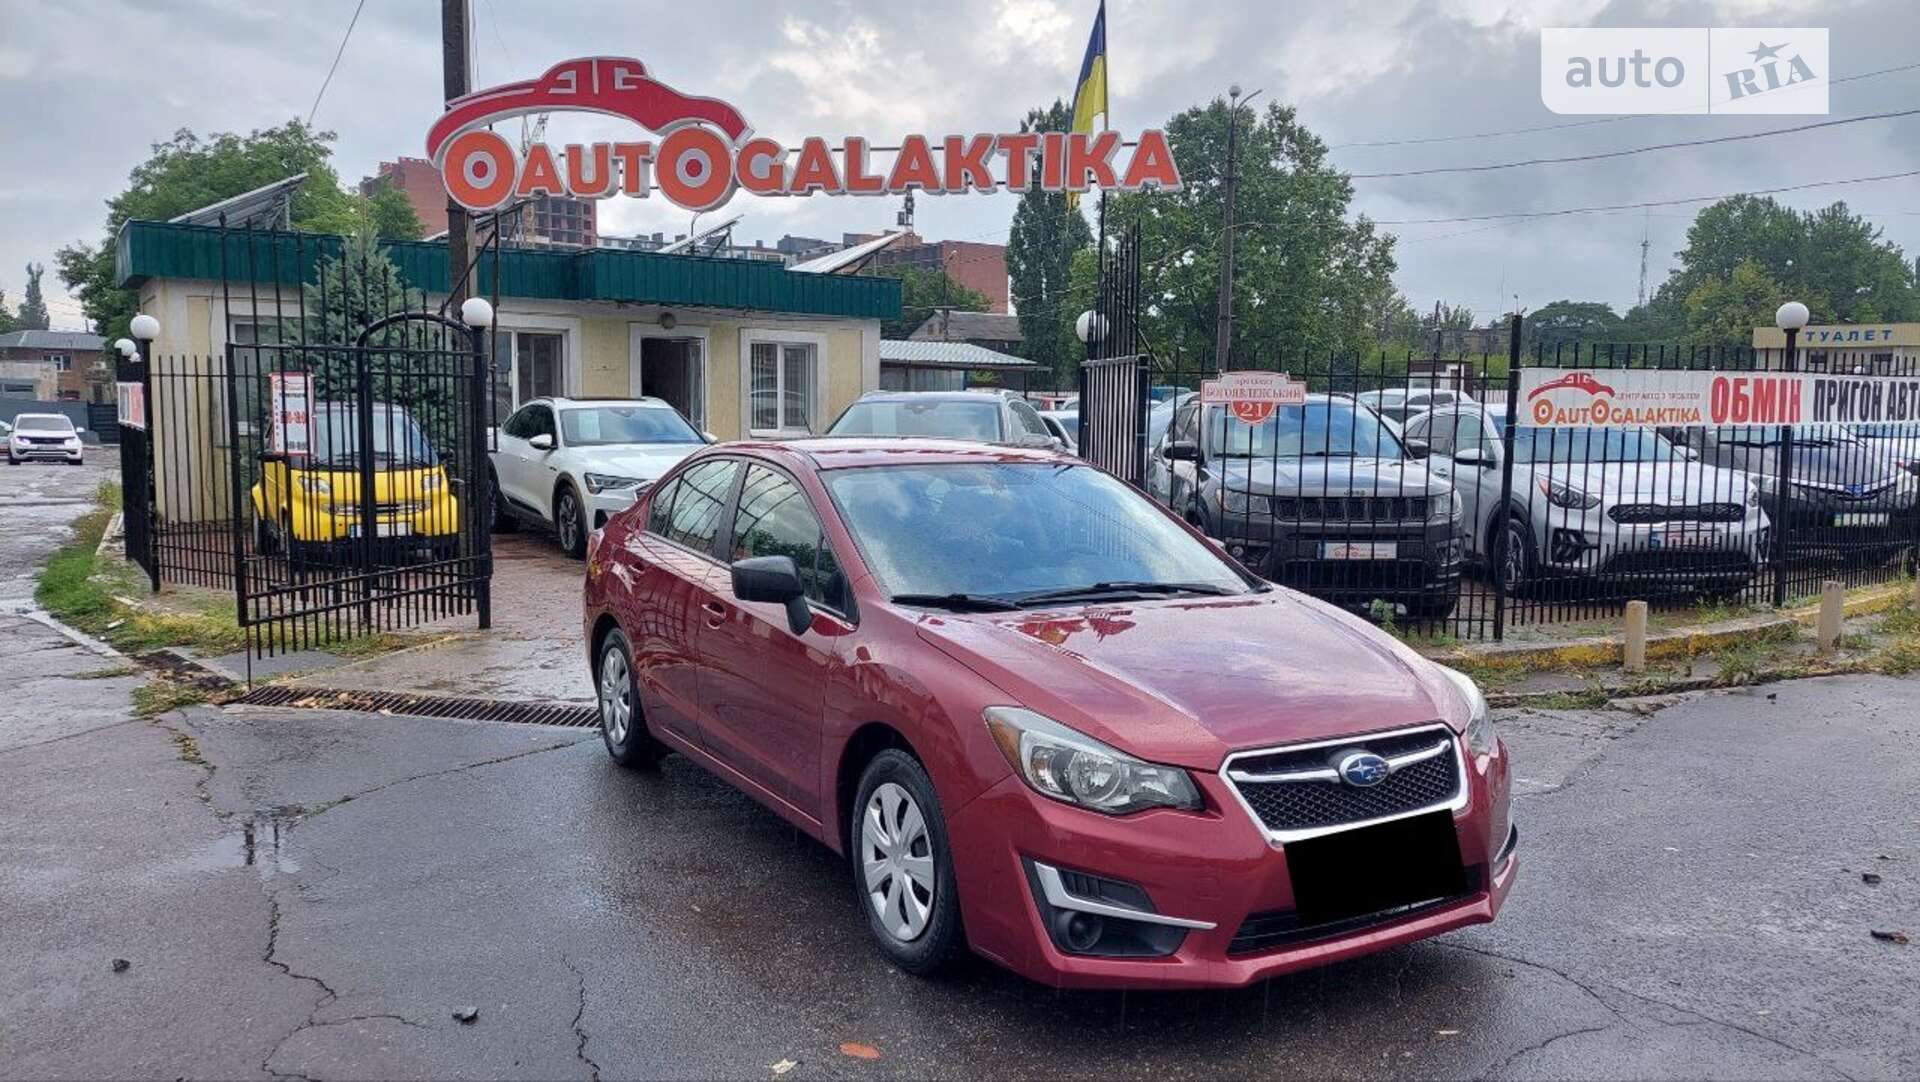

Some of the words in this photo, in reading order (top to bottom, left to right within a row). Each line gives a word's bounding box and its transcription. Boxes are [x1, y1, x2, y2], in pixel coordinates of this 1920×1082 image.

[1805, 329, 1893, 342] ТУАЛЕТ
[1240, 402, 1264, 417] 21
[1711, 375, 1802, 424] ОБМІН
[1813, 379, 1883, 422] ПРИГОН
[1886, 381, 1920, 421] АВТ
